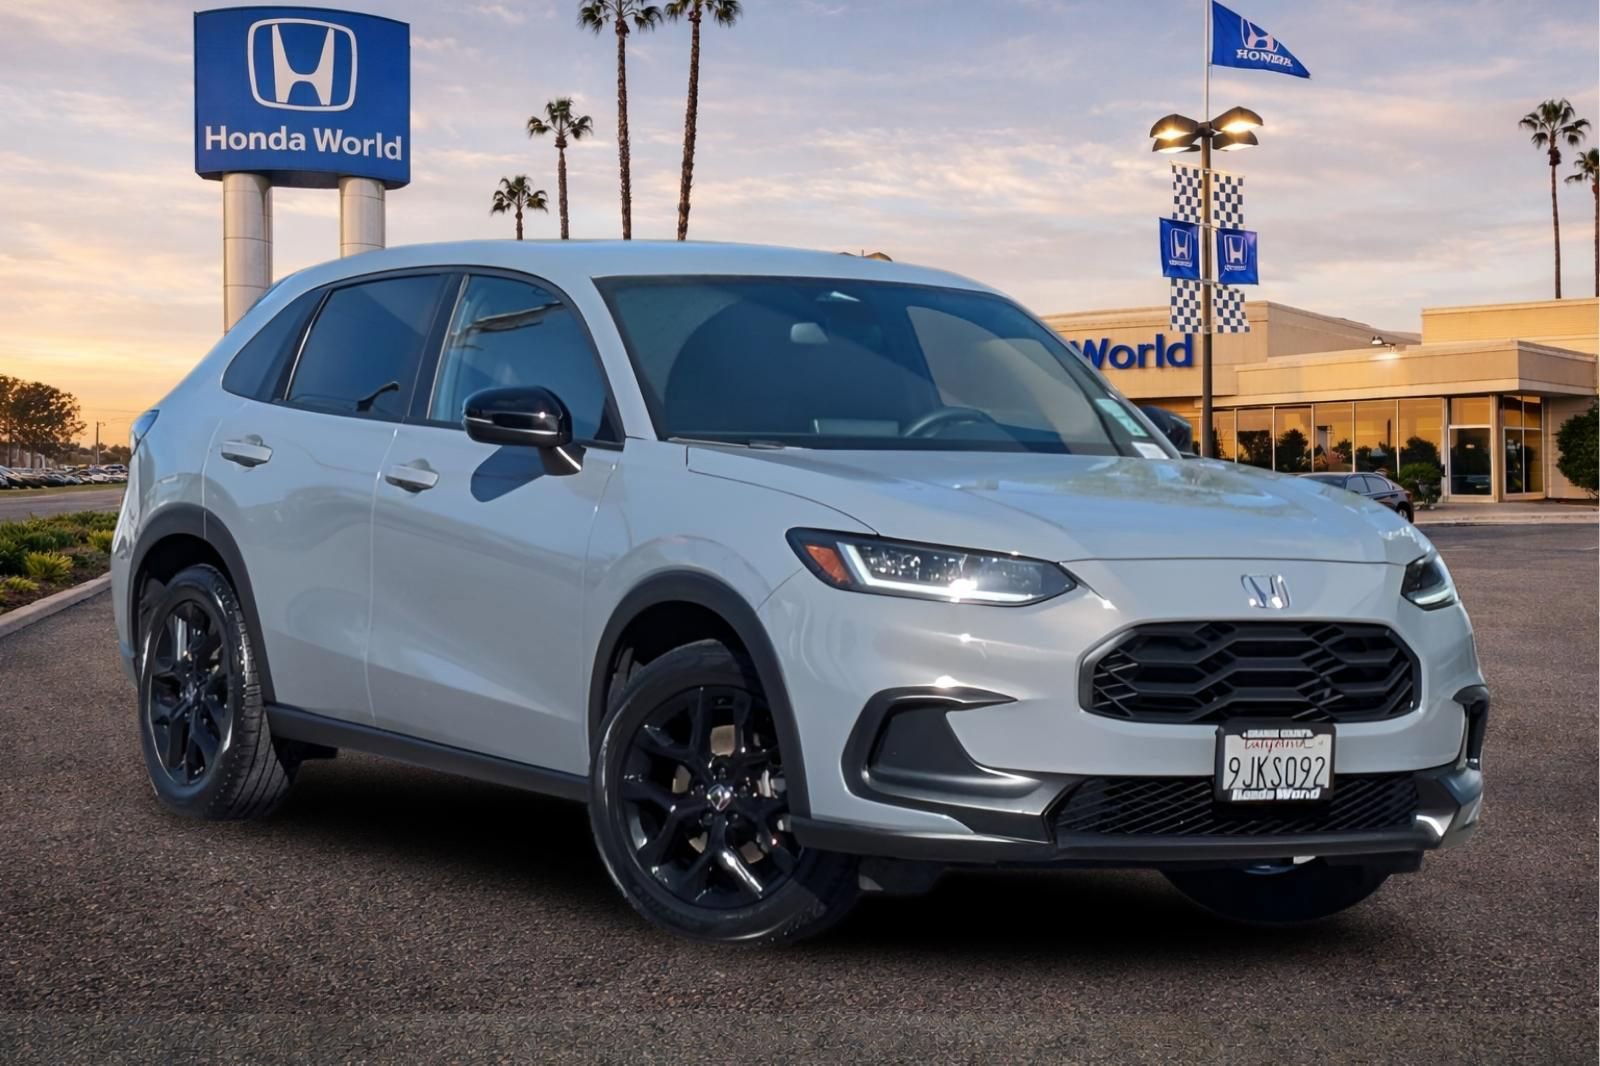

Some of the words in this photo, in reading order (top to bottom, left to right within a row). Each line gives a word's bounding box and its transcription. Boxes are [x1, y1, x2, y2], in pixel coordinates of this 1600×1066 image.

[205, 125, 306, 151] Honda
[313, 127, 402, 160] World
[1070, 333, 1194, 370] World
[1228, 756, 1326, 789] 9JKS092
